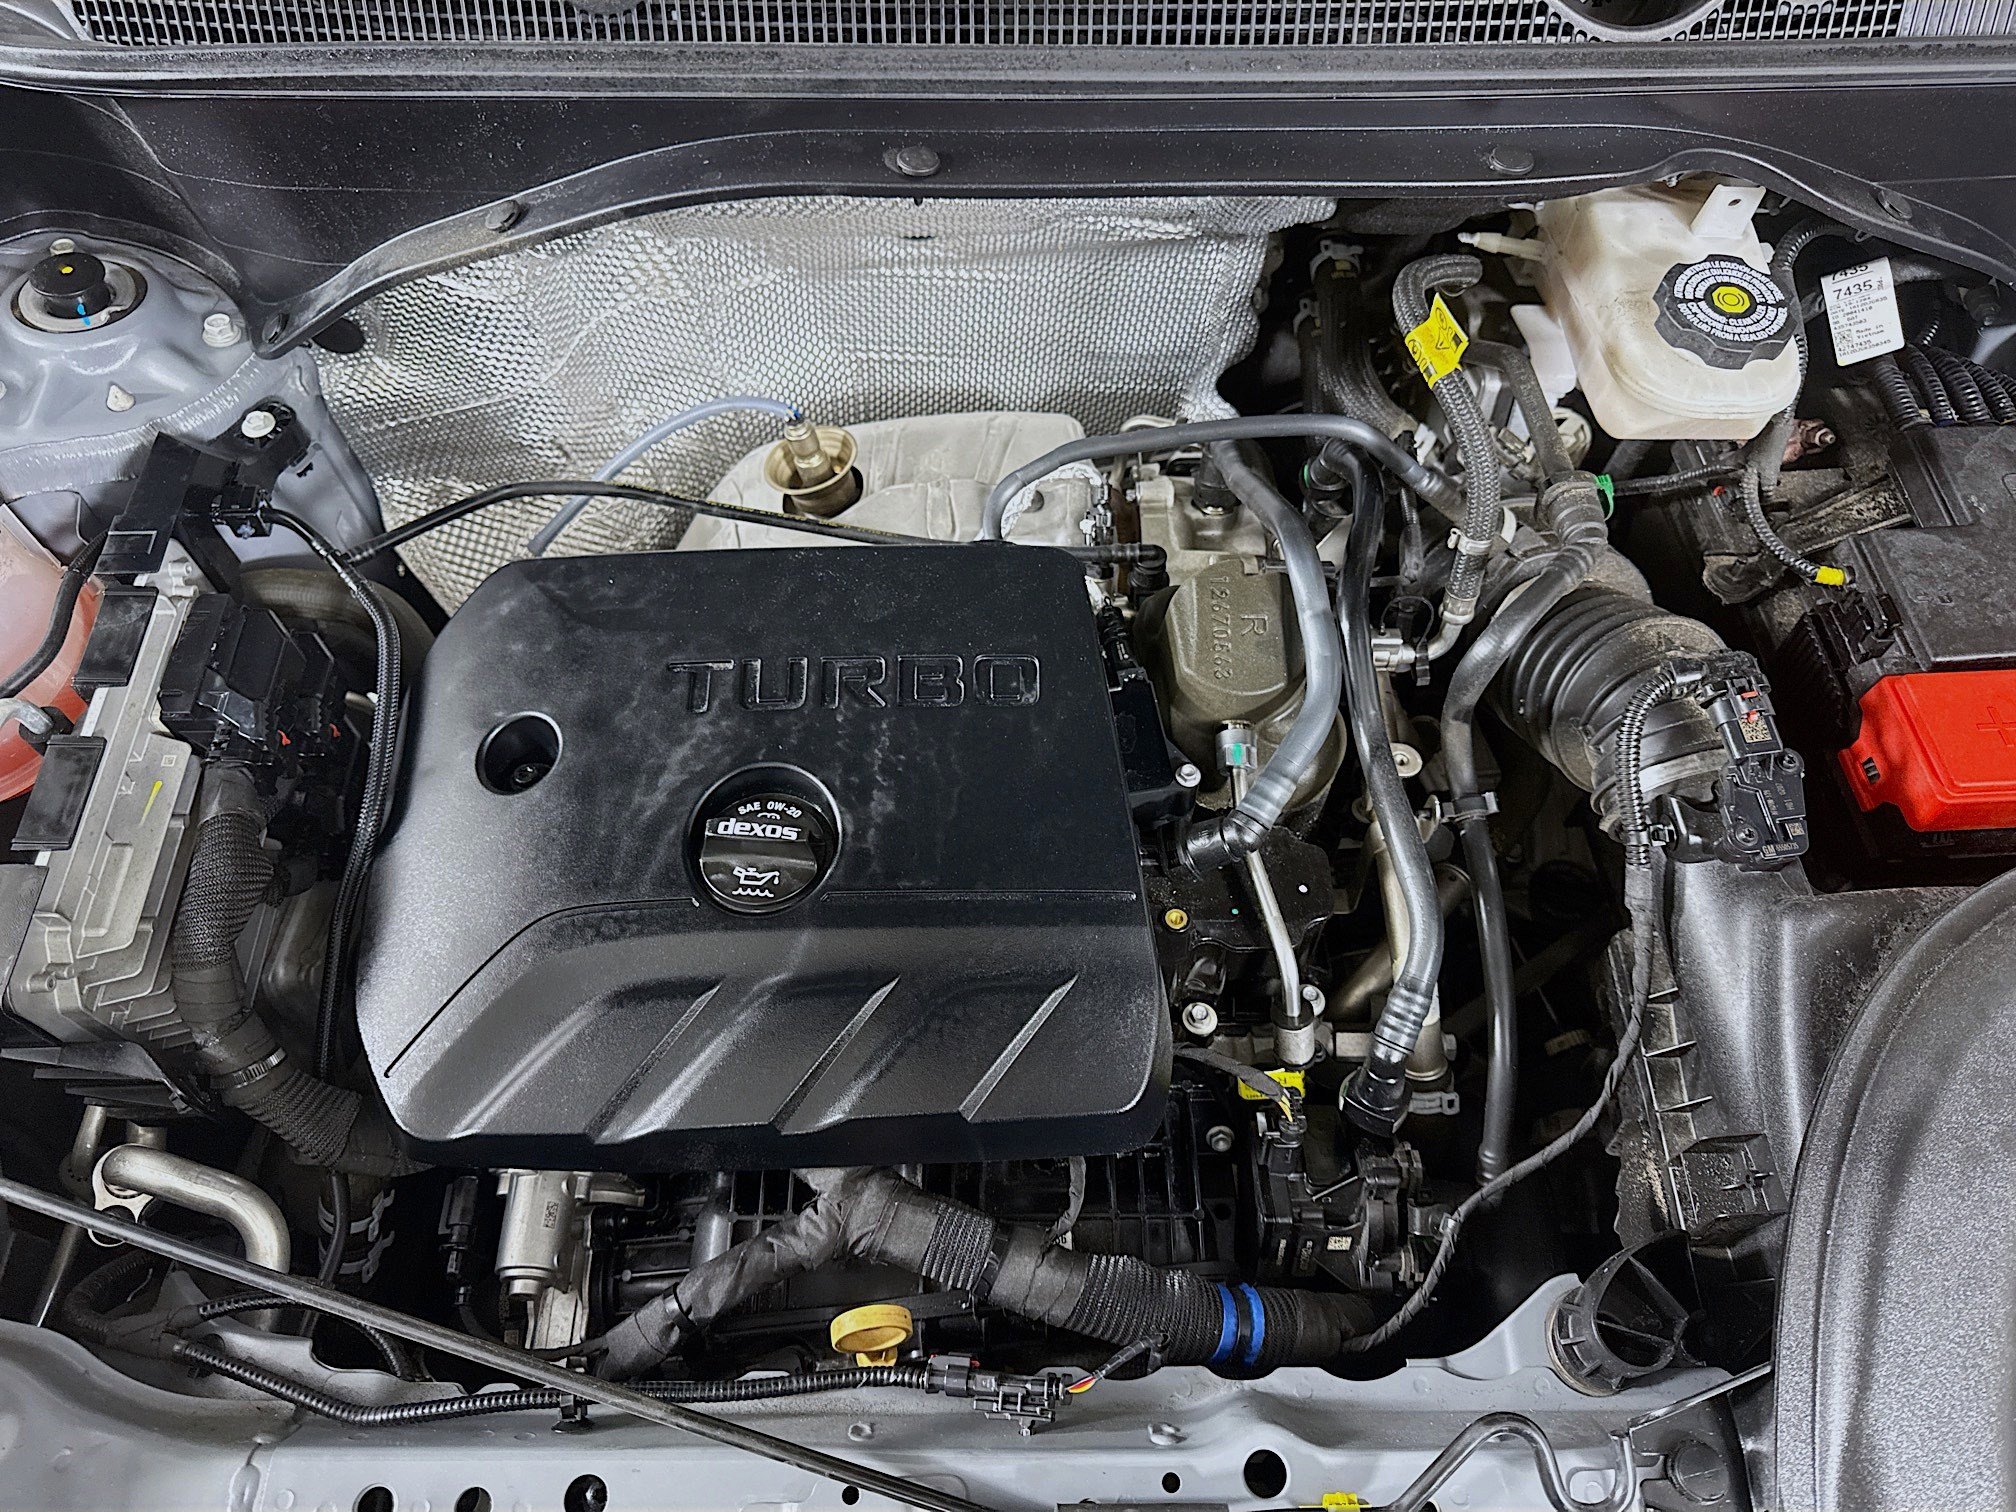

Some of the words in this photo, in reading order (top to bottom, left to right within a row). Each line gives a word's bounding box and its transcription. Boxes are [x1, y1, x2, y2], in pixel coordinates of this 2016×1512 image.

[1833, 279, 1873, 300] 7435
[1690, 317, 1712, 333] FLUID
[1711, 328, 1733, 341] FROM
[1740, 330, 1769, 342] SEALED
[1241, 614, 1268, 636] R
[668, 654, 1041, 713] TURBO
[738, 801, 761, 815] SAE
[767, 801, 802, 819] 0W-20
[717, 818, 799, 840] dexos
[1762, 844, 1776, 854] GM
